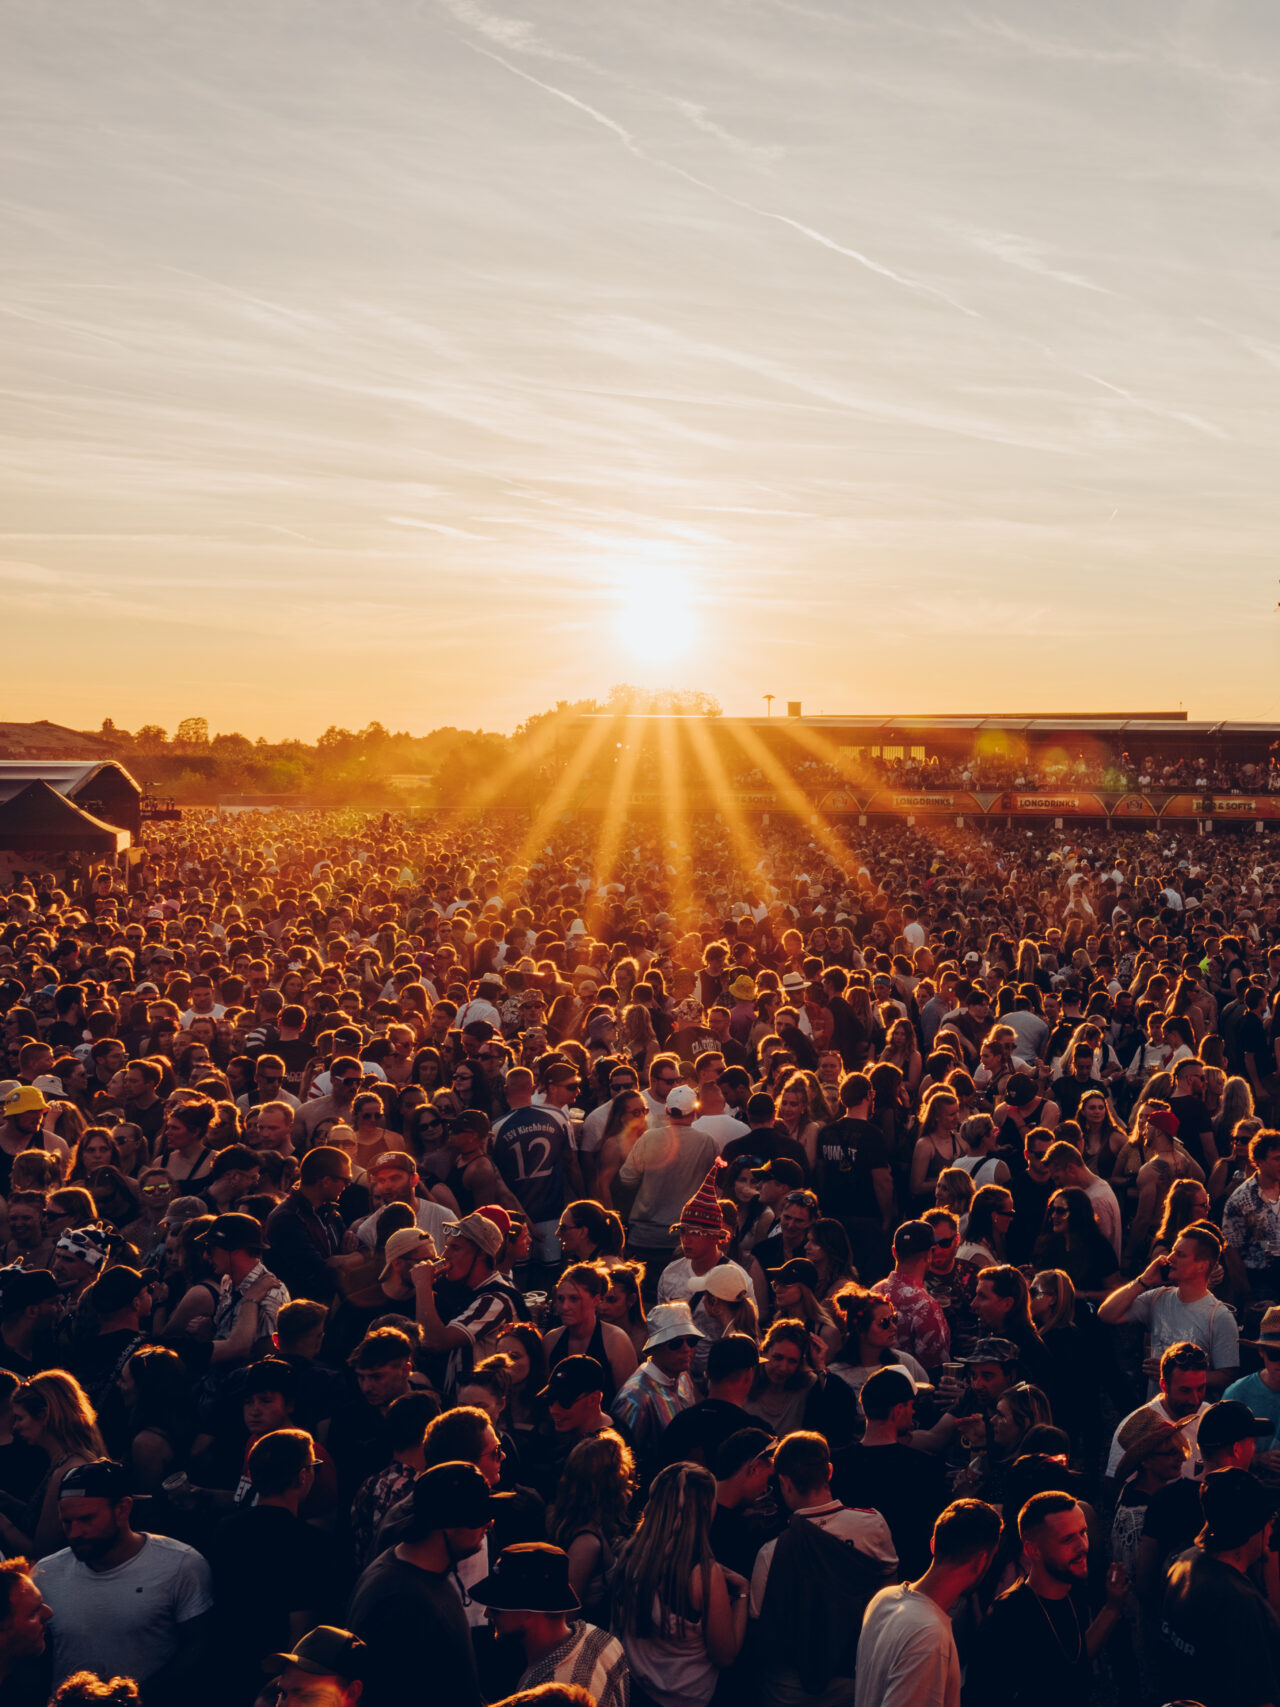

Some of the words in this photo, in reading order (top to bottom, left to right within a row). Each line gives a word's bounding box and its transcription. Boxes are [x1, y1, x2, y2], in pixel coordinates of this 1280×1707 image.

[1020, 799, 1076, 808] LONGDRINKS
[1196, 802, 1216, 811] BR
[1218, 802, 1224, 811] &
[1226, 802, 1252, 811] SOFTS
[503, 1129, 517, 1142] TSV
[517, 1122, 556, 1135] Kirchheim
[508, 1136, 554, 1181] 12
